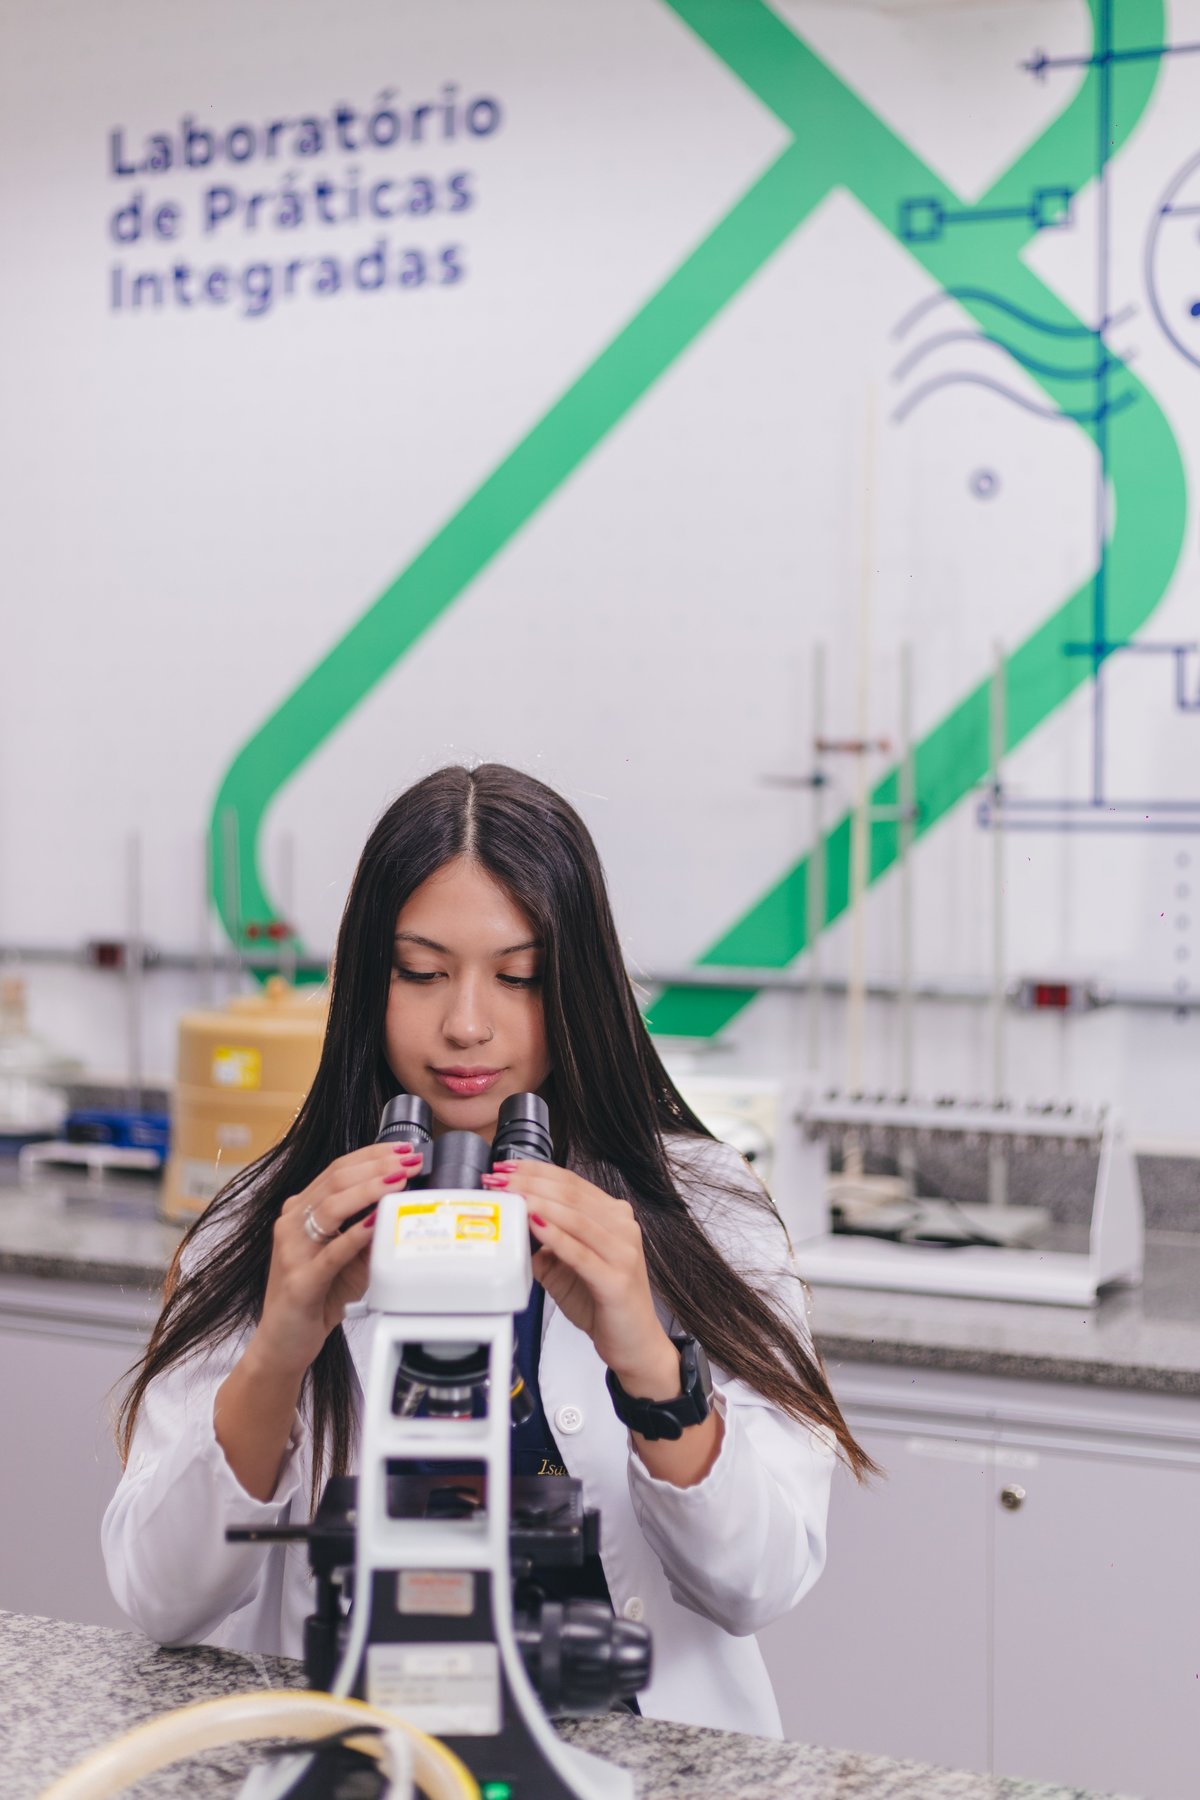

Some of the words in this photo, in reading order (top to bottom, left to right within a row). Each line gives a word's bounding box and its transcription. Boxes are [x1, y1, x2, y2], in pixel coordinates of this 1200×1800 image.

[109, 83, 503, 176] Laboratório
[109, 189, 180, 243] de
[204, 168, 474, 232] Práticas
[110, 237, 464, 317] Integradas
